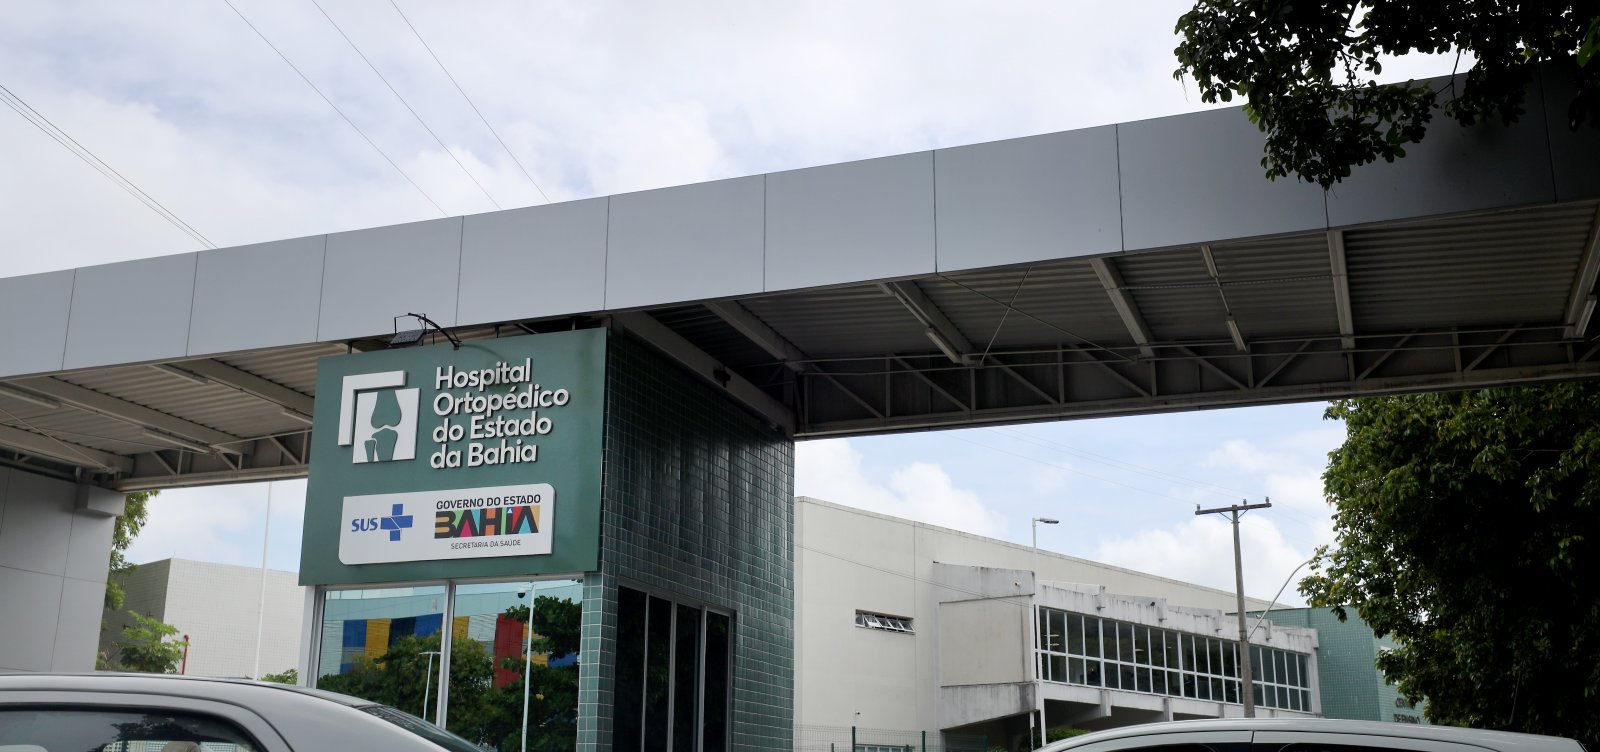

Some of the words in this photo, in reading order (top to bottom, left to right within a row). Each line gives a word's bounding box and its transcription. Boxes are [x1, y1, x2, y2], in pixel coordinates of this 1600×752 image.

[435, 357, 531, 392] Hospital
[433, 383, 570, 418] Ortopédico
[432, 418, 464, 443] do
[470, 410, 552, 440] Estado
[430, 443, 461, 469] da
[467, 438, 537, 467] Bahia
[436, 499, 484, 510] GOVERNO
[486, 497, 501, 507] DO
[503, 494, 541, 505] ESTADO
[351, 517, 378, 532] SUS
[450, 541, 489, 550] SECRETARIA
[499, 538, 521, 547] SAÚDE
